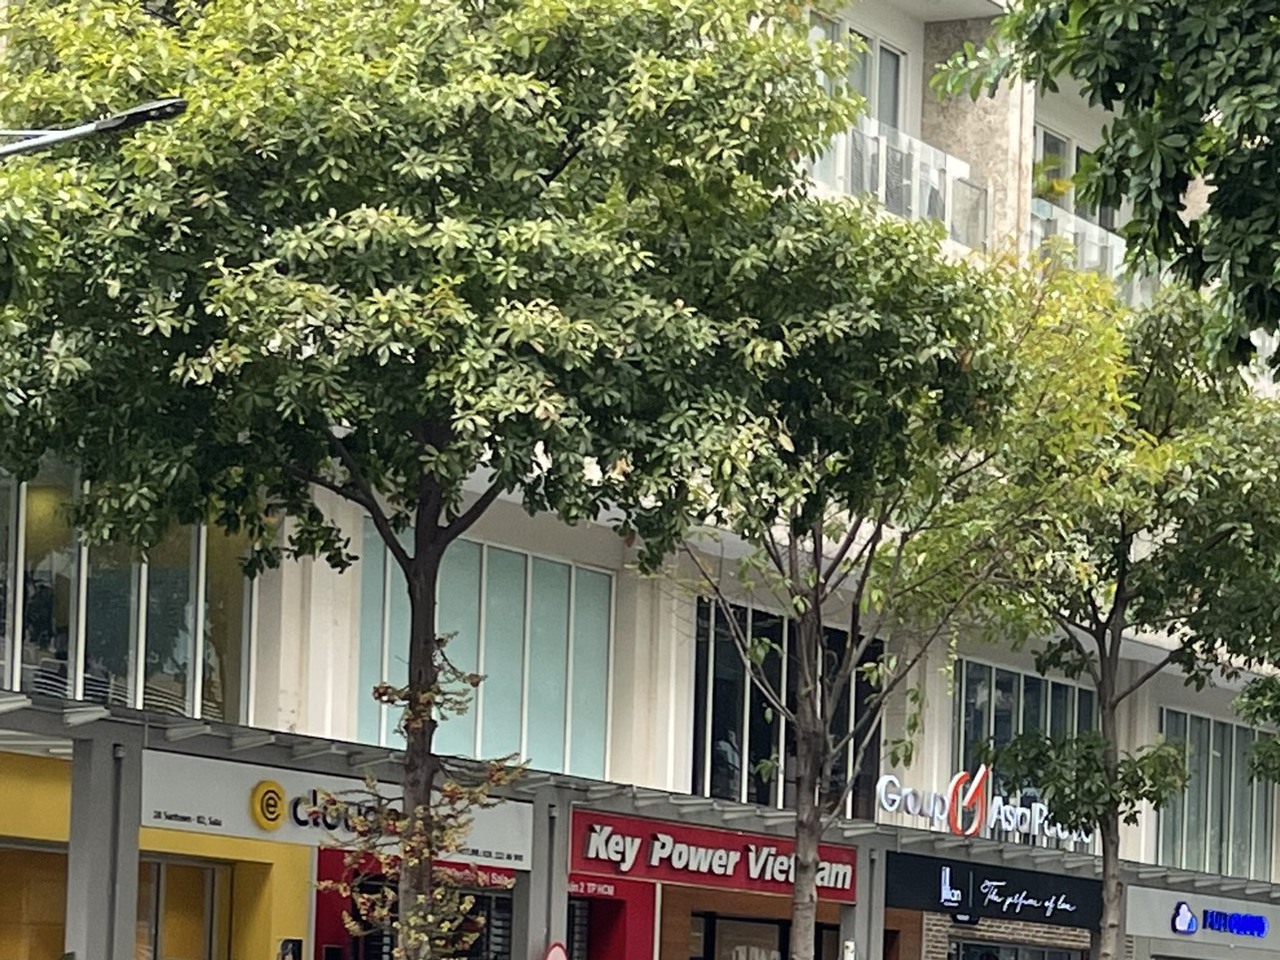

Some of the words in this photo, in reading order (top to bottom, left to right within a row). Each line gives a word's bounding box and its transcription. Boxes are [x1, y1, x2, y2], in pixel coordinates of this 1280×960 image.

[876, 774, 949, 832] Group
[586, 824, 642, 872] Key
[650, 833, 741, 876] Power
[747, 844, 853, 890] Vietam
